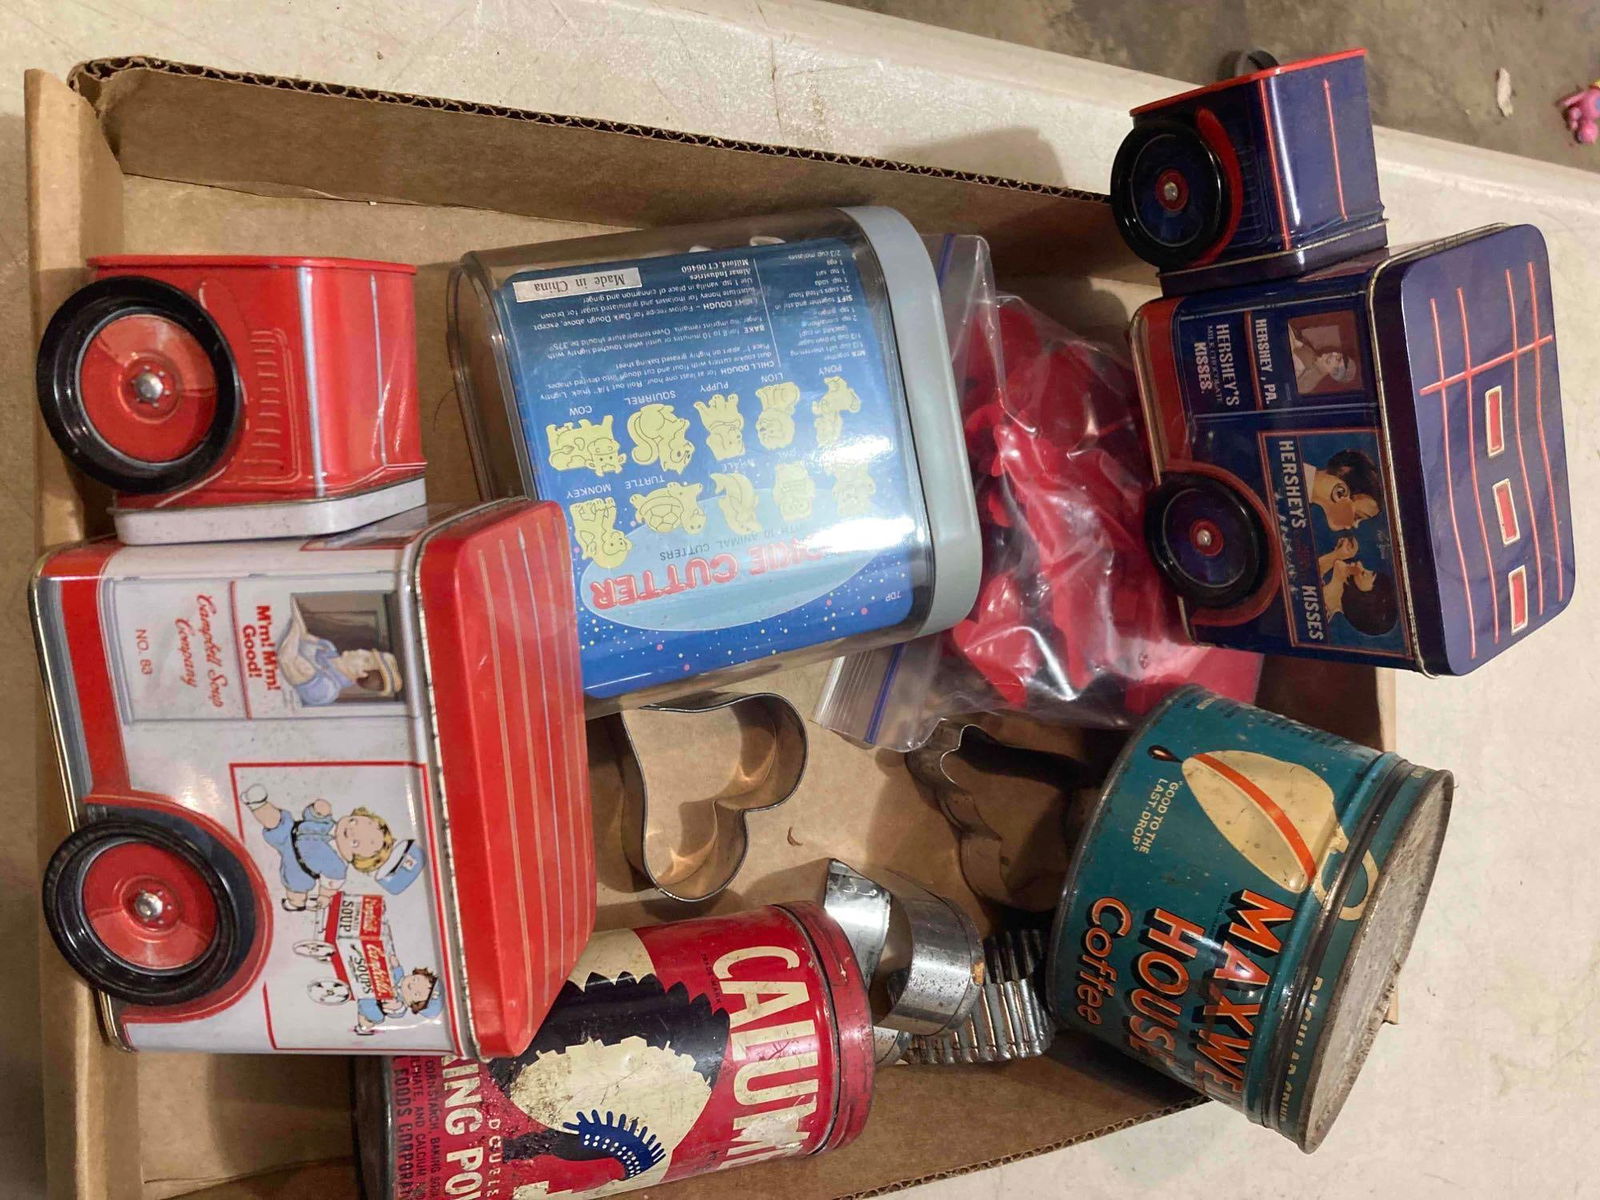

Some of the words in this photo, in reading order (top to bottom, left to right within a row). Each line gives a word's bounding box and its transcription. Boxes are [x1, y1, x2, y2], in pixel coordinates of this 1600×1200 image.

[680, 263, 706, 272] 06460
[728, 266, 751, 276] Almar
[574, 277, 587, 290] in
[593, 273, 625, 288] Made
[688, 270, 727, 282] Industries
[739, 276, 752, 284] Use
[532, 280, 568, 294] China
[702, 299, 732, 309] DOUGH
[836, 293, 853, 303] SIFT
[613, 311, 631, 321] Dark
[667, 304, 693, 314] Follow
[586, 314, 611, 324] Dough
[652, 327, 670, 336] Oven
[742, 324, 765, 334] BAKE
[751, 359, 775, 369] CHILL
[1214, 322, 1240, 407] HERSHEY'S
[1253, 317, 1273, 373] HERSHEY
[1263, 382, 1278, 404] PA.
[720, 364, 749, 374] DOUGH
[817, 364, 842, 374] PONY
[626, 379, 642, 389] Roll
[760, 373, 784, 382] LION
[611, 382, 625, 390] out
[698, 381, 729, 392] PUPPY
[538, 391, 567, 401] Lightly
[623, 390, 676, 405] SQUIRREL
[568, 405, 592, 415] COW
[623, 475, 665, 488] TURTLE
[564, 483, 611, 498] MONKEY
[1279, 439, 1306, 530] HERSHEY'S
[1300, 583, 1323, 642] KISSES
[659, 543, 710, 561] CUTTERS
[590, 553, 739, 609] CUTTER
[195, 594, 223, 667] Campbell
[256, 605, 273, 646] M'm!
[134, 628, 149, 655] NO.
[173, 617, 200, 688] Company
[242, 624, 261, 678] Good!
[205, 668, 230, 707] Soup
[1147, 777, 1168, 808] LAST
[1149, 816, 1164, 830] TO
[1140, 832, 1158, 854] THE
[340, 900, 354, 932] SOUP
[1077, 897, 1133, 1025] Coffee
[354, 957, 373, 994] SOUPS
[1129, 908, 1205, 1059] HOUSE
[394, 1068, 412, 1117] FOODS
[415, 1107, 425, 1128] AND
[416, 1134, 427, 1176] CALCIUM
[431, 1137, 441, 1173] BAKING
[487, 1119, 501, 1198] DOUBLE
